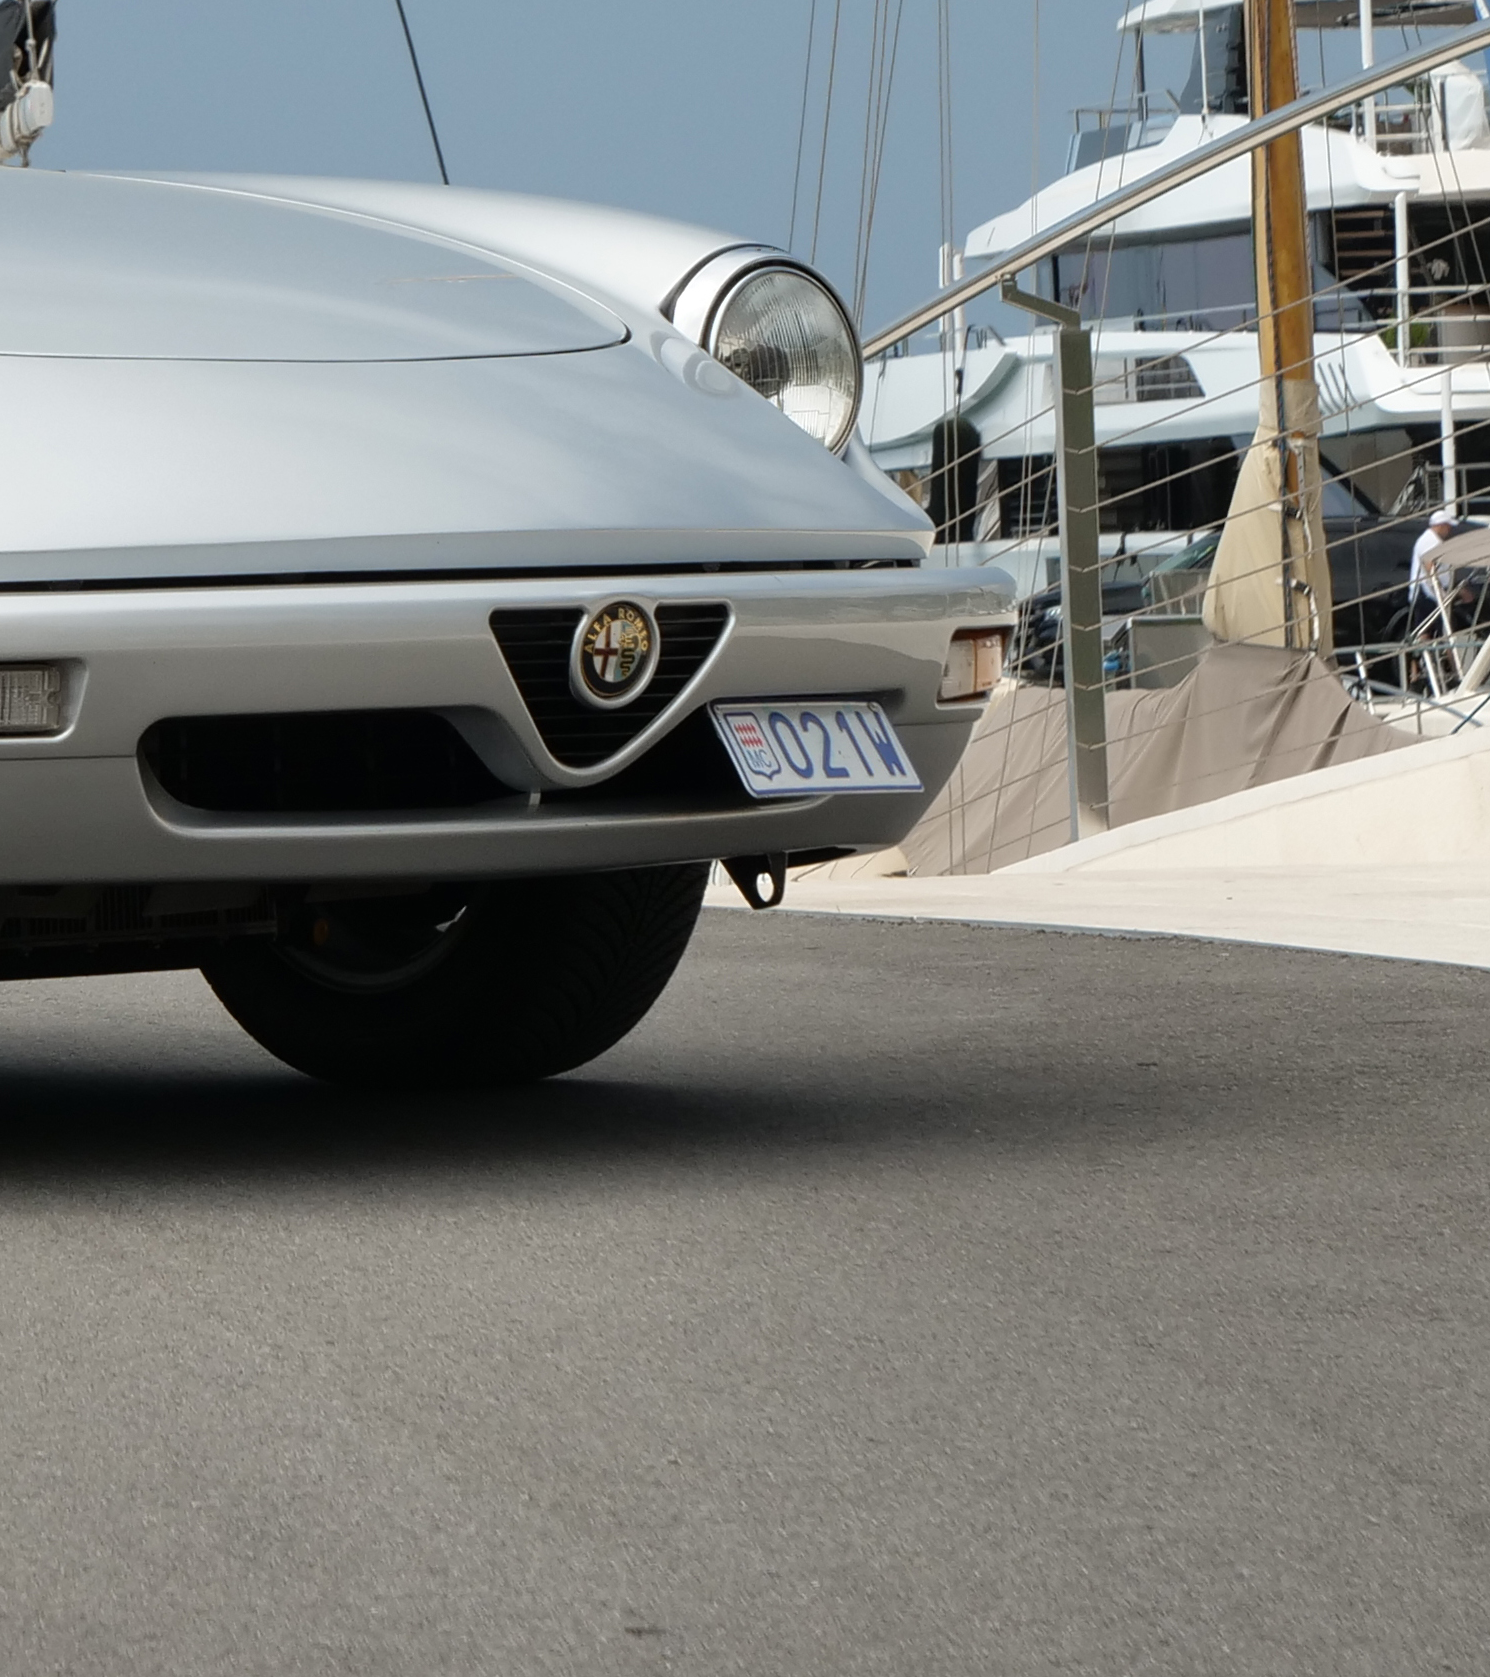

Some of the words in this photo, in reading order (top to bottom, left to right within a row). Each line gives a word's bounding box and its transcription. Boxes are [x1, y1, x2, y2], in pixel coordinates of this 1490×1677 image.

[583, 613, 612, 653] ALFA
[618, 606, 650, 652] ROMEO
[747, 748, 773, 769] MC
[768, 710, 907, 779] 021W
